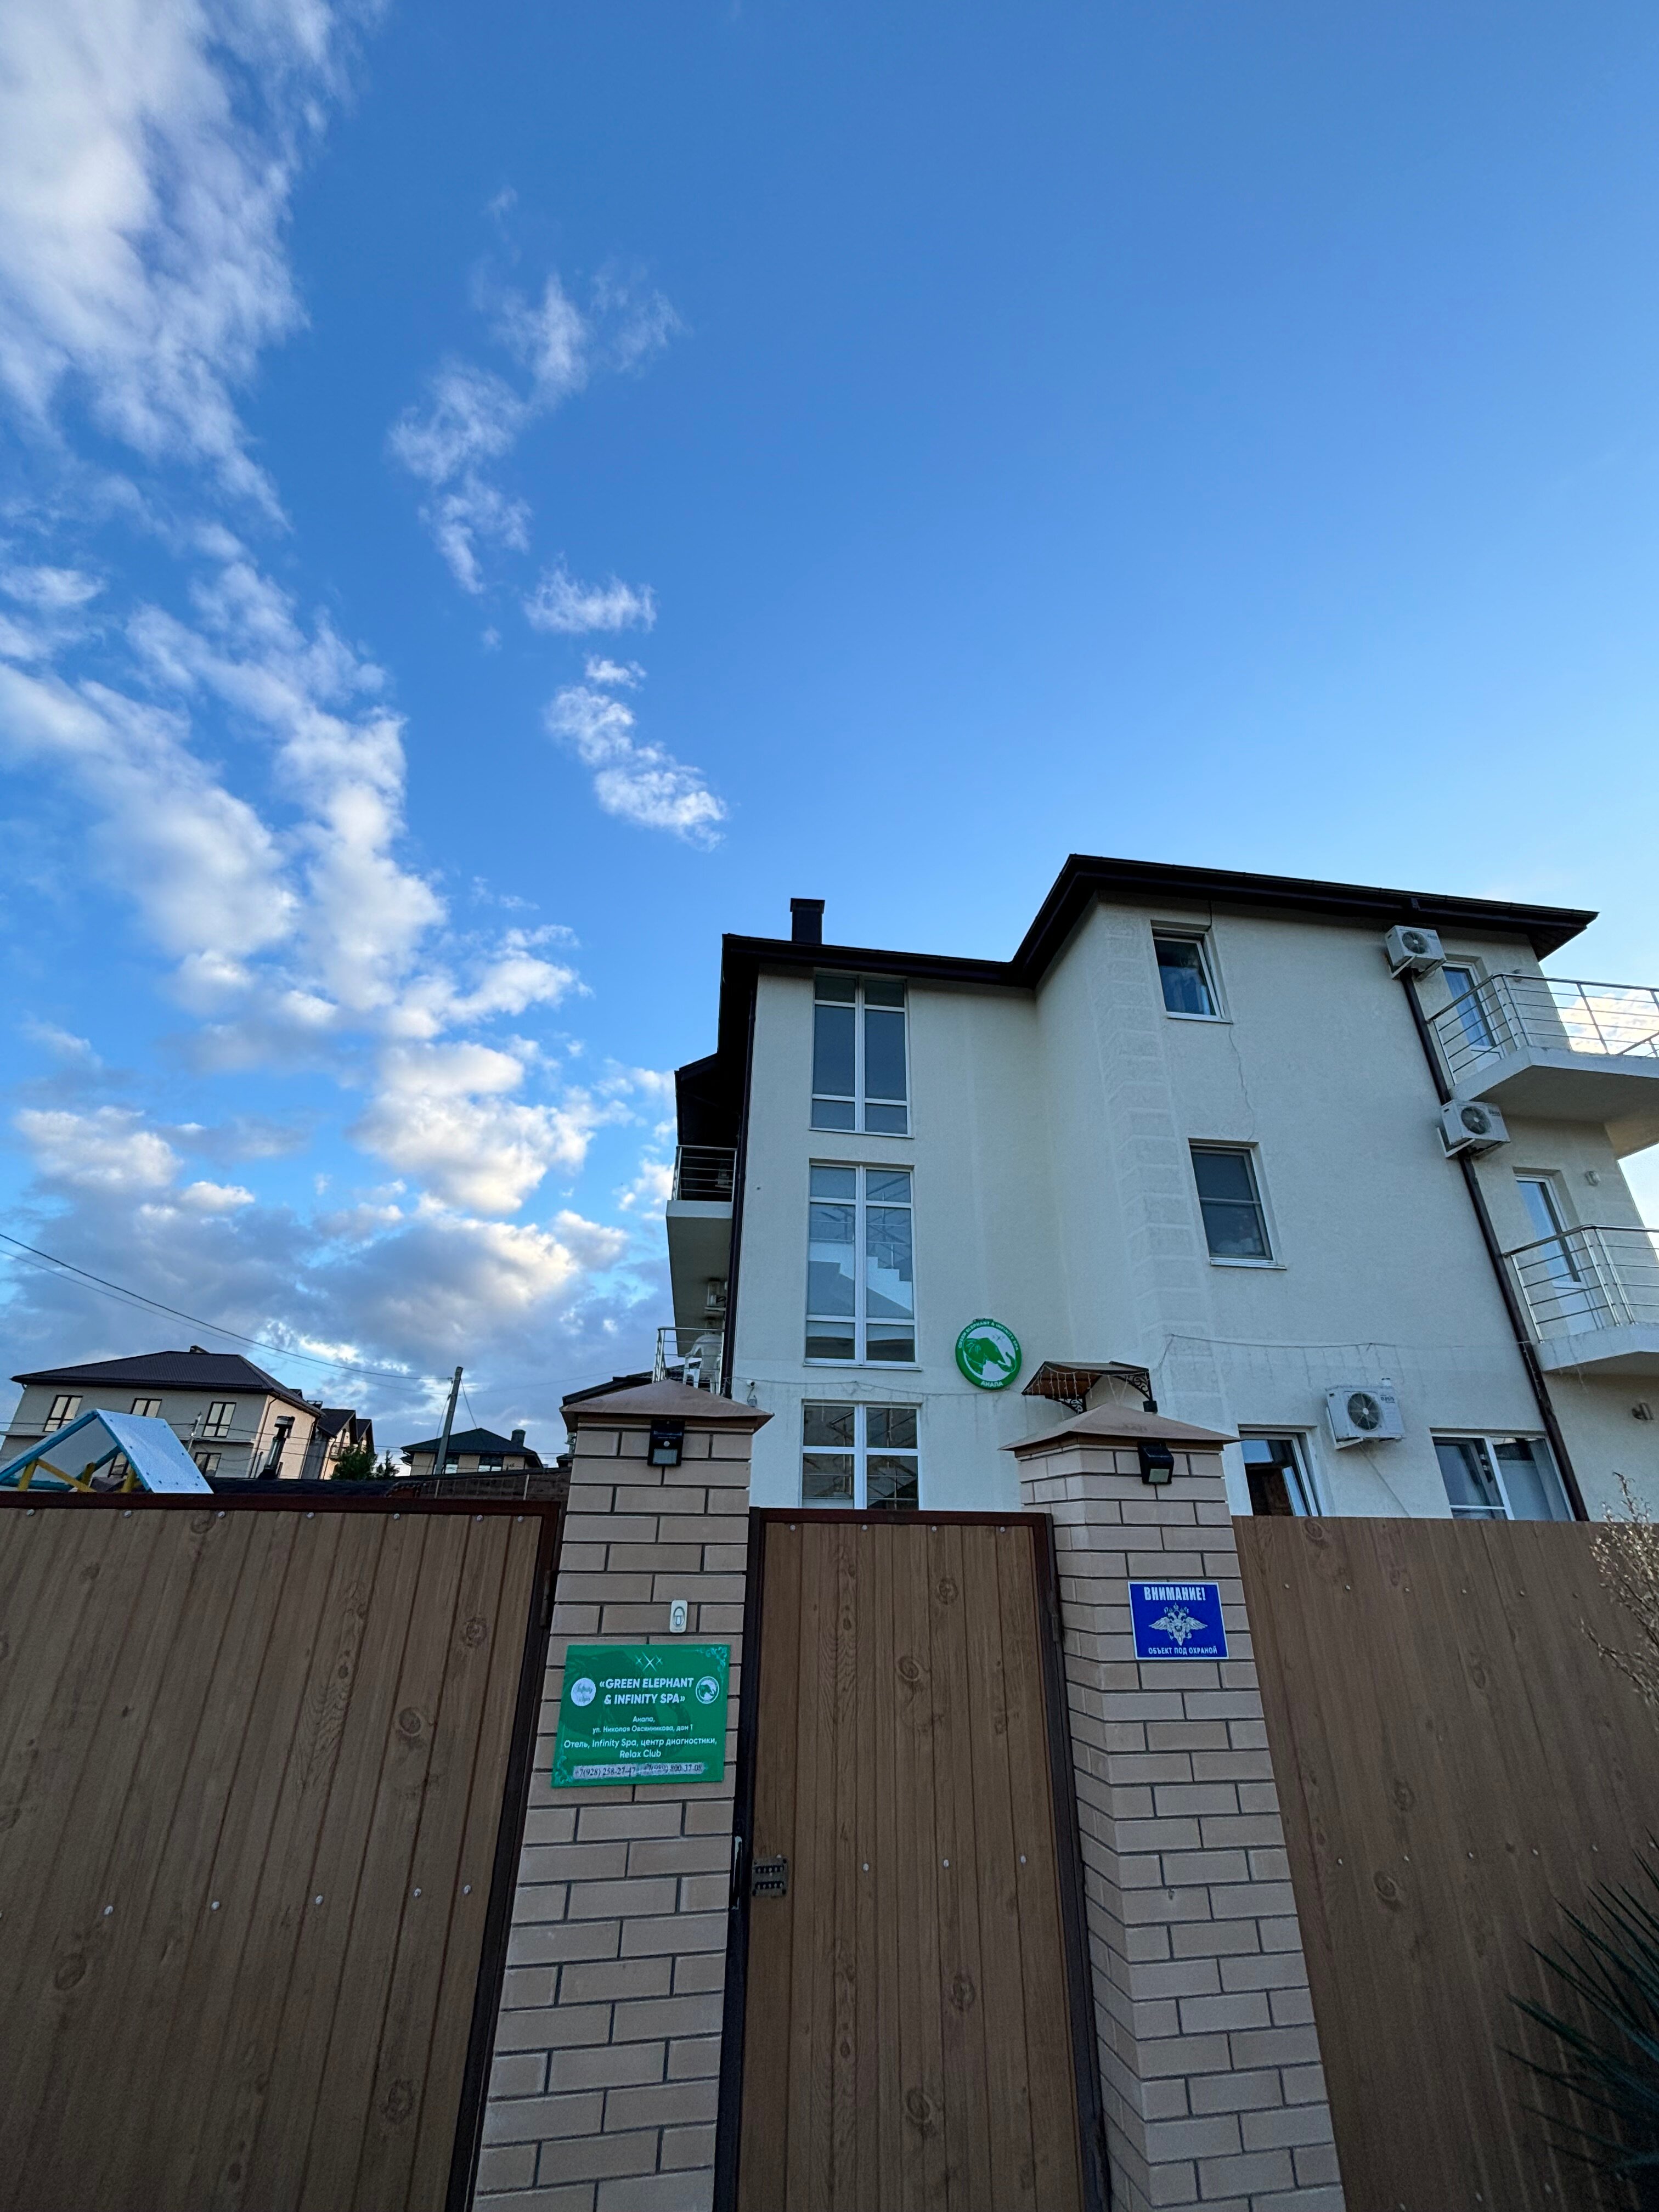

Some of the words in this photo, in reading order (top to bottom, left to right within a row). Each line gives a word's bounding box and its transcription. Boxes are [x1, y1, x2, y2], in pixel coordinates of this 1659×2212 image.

[1144, 1587, 1206, 1601] ВНИМАНИЕ!
[1174, 1647, 1188, 1655] ПОД
[1189, 1645, 1217, 1654] ОХРАНОЙ
[600, 1679, 640, 1689] «GREEN
[642, 1678, 694, 1688] ELEPHANT
[604, 1695, 612, 1704] &
[614, 1694, 657, 1704] INFINITY
[661, 1693, 685, 1703] SPA»
[564, 1740, 590, 1749] Отель,
[592, 1740, 619, 1748] Infinity
[621, 1739, 639, 1748] Spa,
[641, 1739, 664, 1747] центр
[666, 1736, 717, 1746] диагностики,
[620, 1750, 641, 1758] Relax
